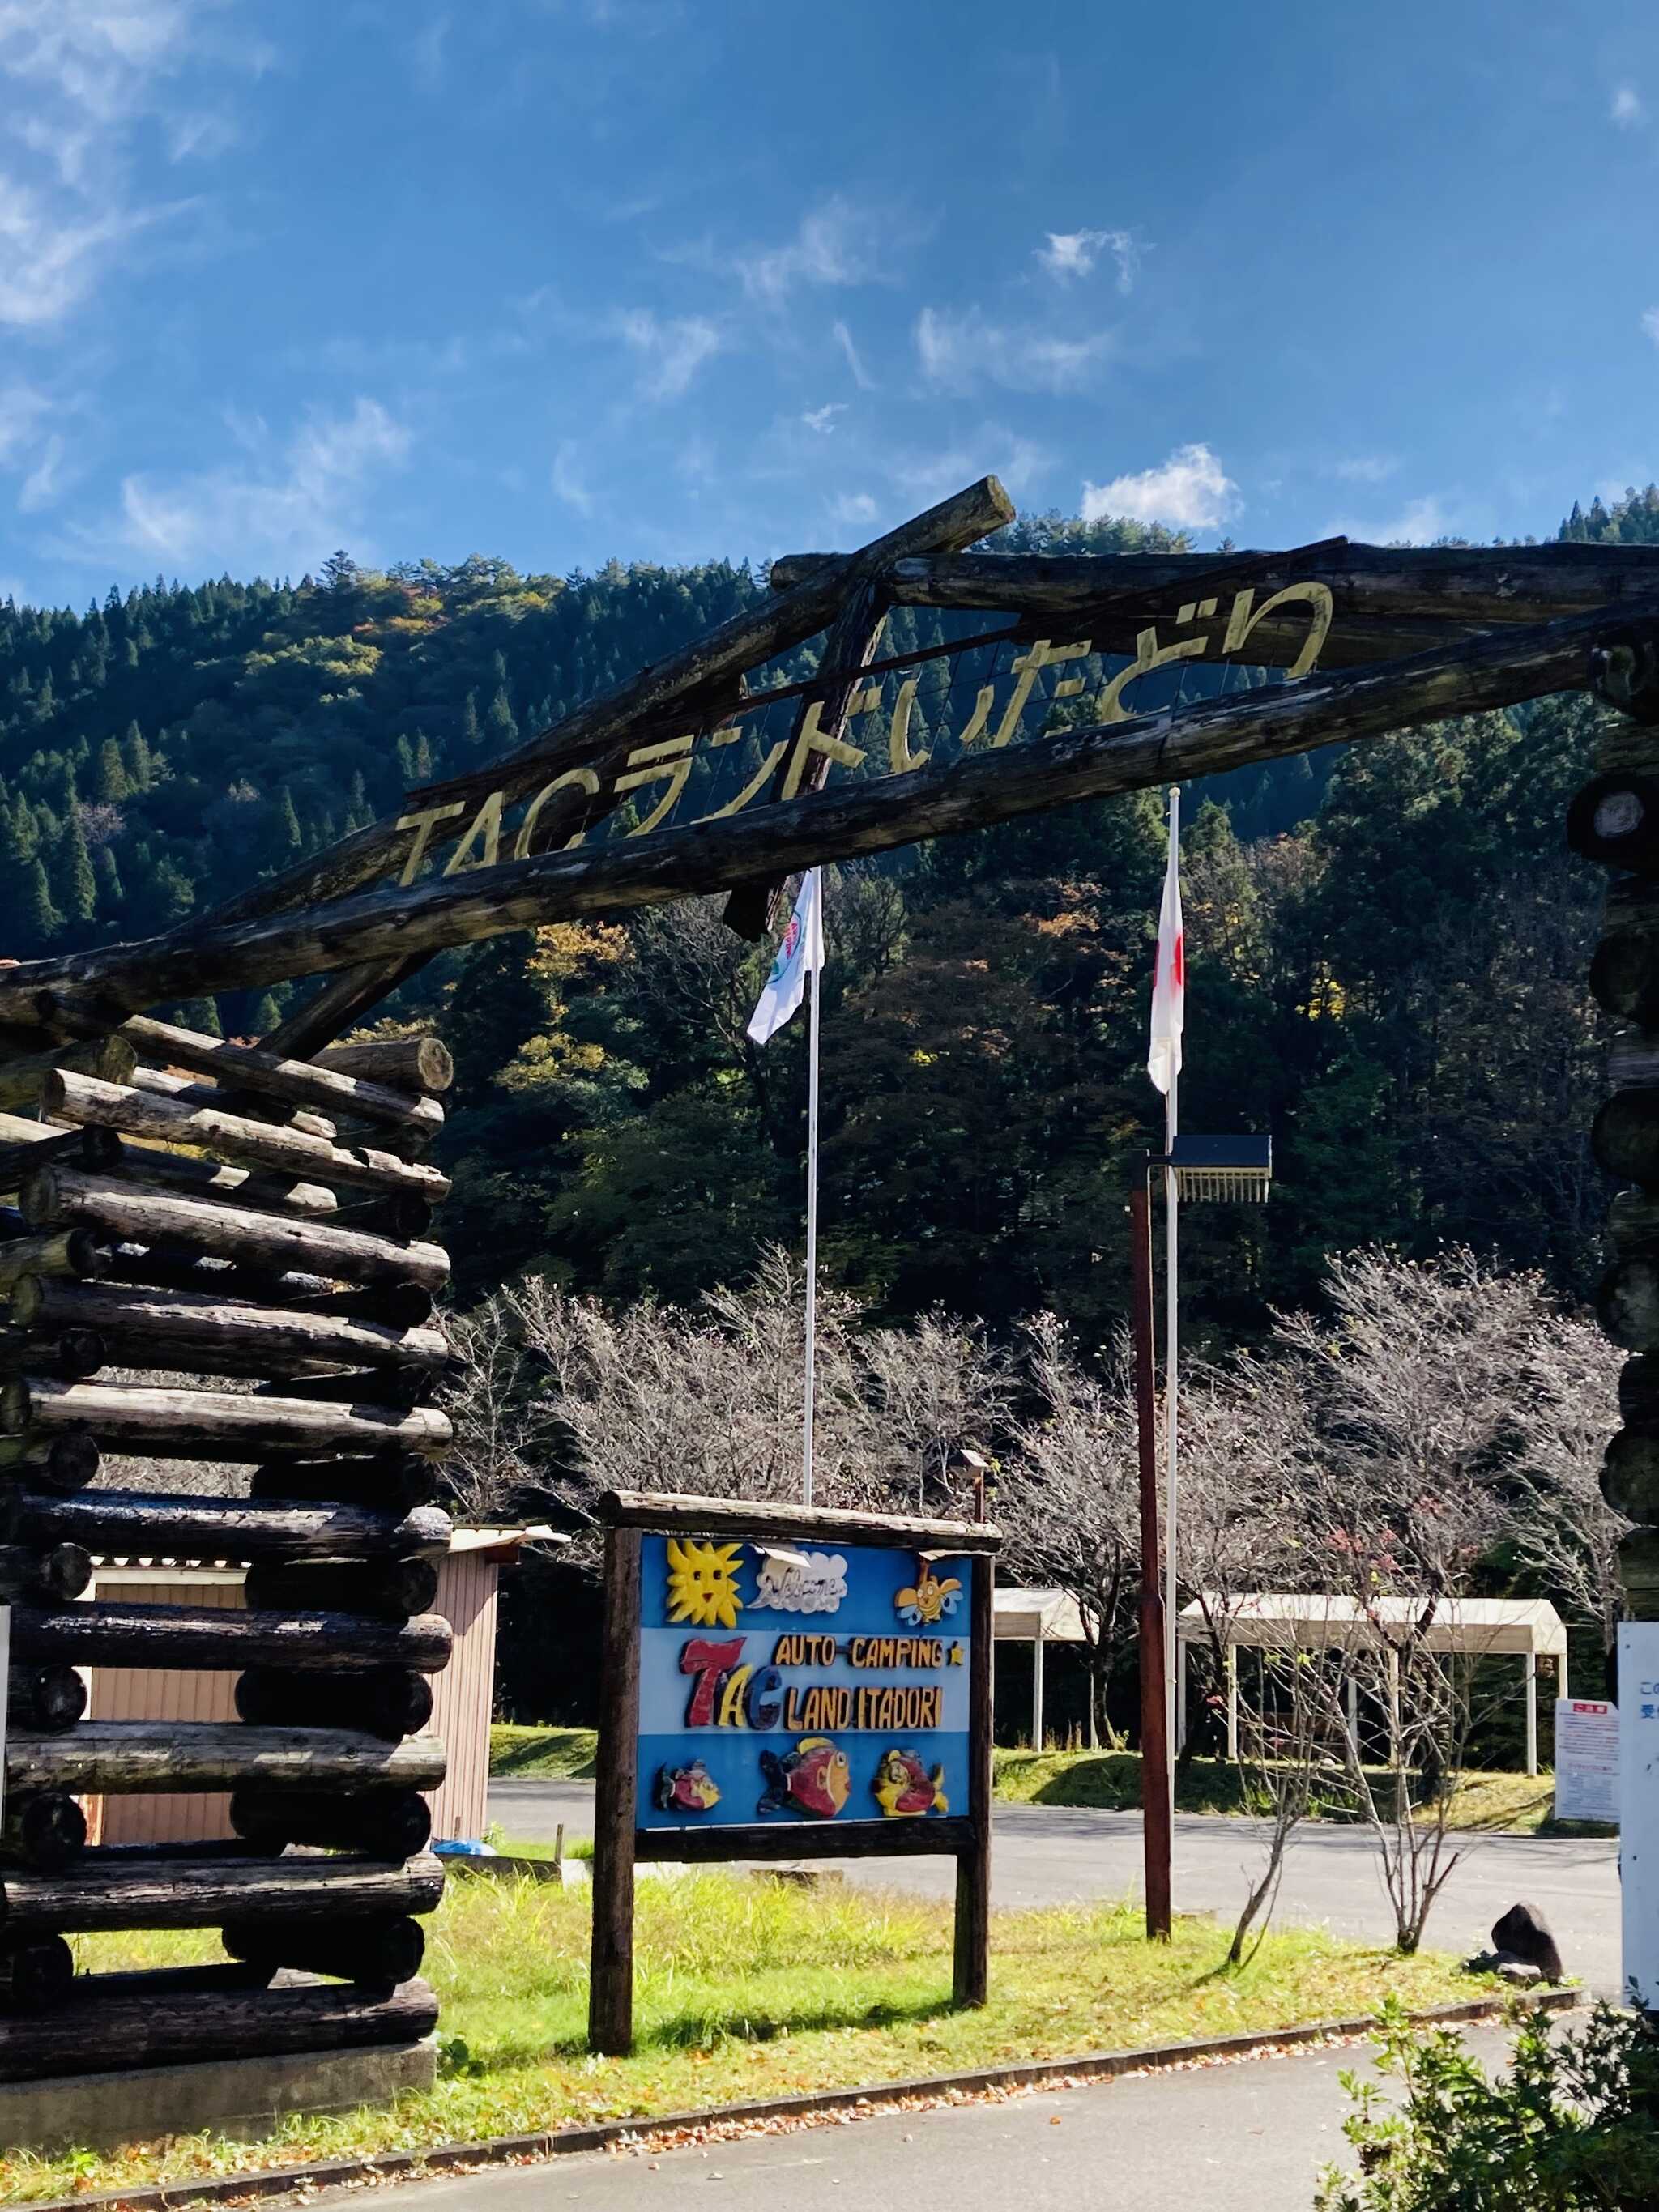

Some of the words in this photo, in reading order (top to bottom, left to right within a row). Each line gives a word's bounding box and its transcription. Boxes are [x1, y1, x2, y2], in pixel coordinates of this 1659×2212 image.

[680, 1636, 783, 1730] TAC
[783, 1687, 849, 1730] LAND
[853, 1686, 943, 1729] ITADORI
